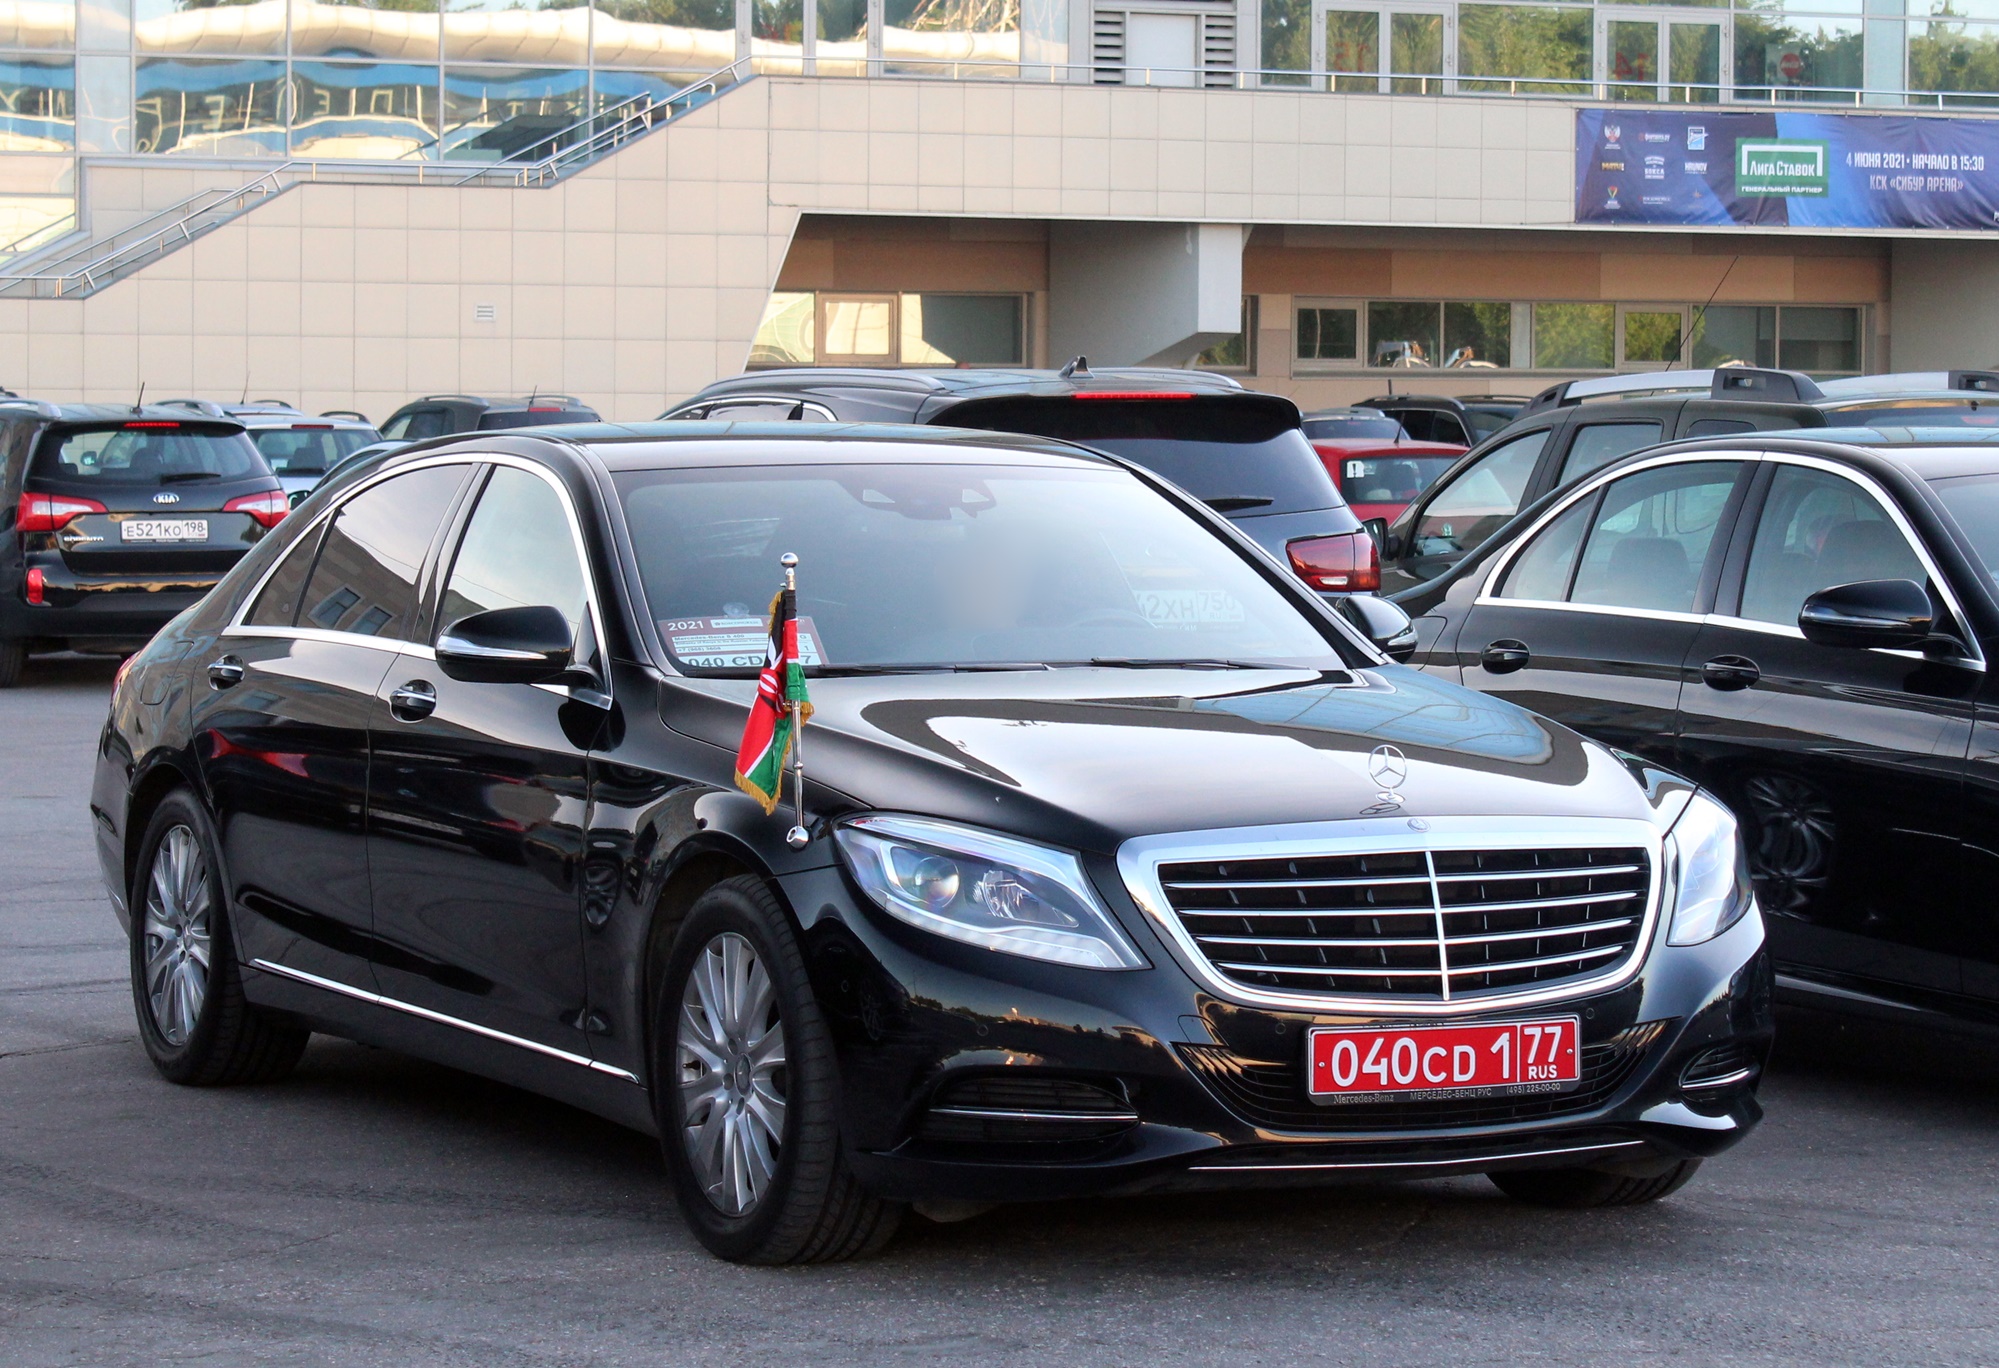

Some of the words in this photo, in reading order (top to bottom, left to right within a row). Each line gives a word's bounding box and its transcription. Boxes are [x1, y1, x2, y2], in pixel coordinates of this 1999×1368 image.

[1846, 152, 1852, 168] 4
[1854, 152, 1881, 168] ИЮНЯ
[1883, 153, 1905, 169] 2021
[1912, 154, 1949, 170] НАЧАЛО
[1951, 154, 1958, 170] В
[1960, 156, 1984, 171] 15:30
[1870, 175, 1888, 190] КСК
[1890, 176, 1924, 191] «СИБУР
[1926, 177, 1964, 192] АРЕНА»
[158, 494, 175, 503] KIA
[184, 522, 204, 532] 198
[668, 620, 704, 632] 2021
[732, 656, 763, 666] CD
[1331, 1036, 1476, 1087] 040CD
[1490, 1032, 1510, 1079] 1
[1523, 1026, 1563, 1064] 77
[1528, 1064, 1558, 1080] RUS
[1334, 1093, 1394, 1104] Mercedes-Benz
[1410, 1089, 1477, 1101] МЕРСЕДЕС-БЕНЦ
[1478, 1088, 1492, 1097] РУС
[1506, 1085, 1525, 1095] (495)
[1526, 1083, 1560, 1093] 225-00-00
